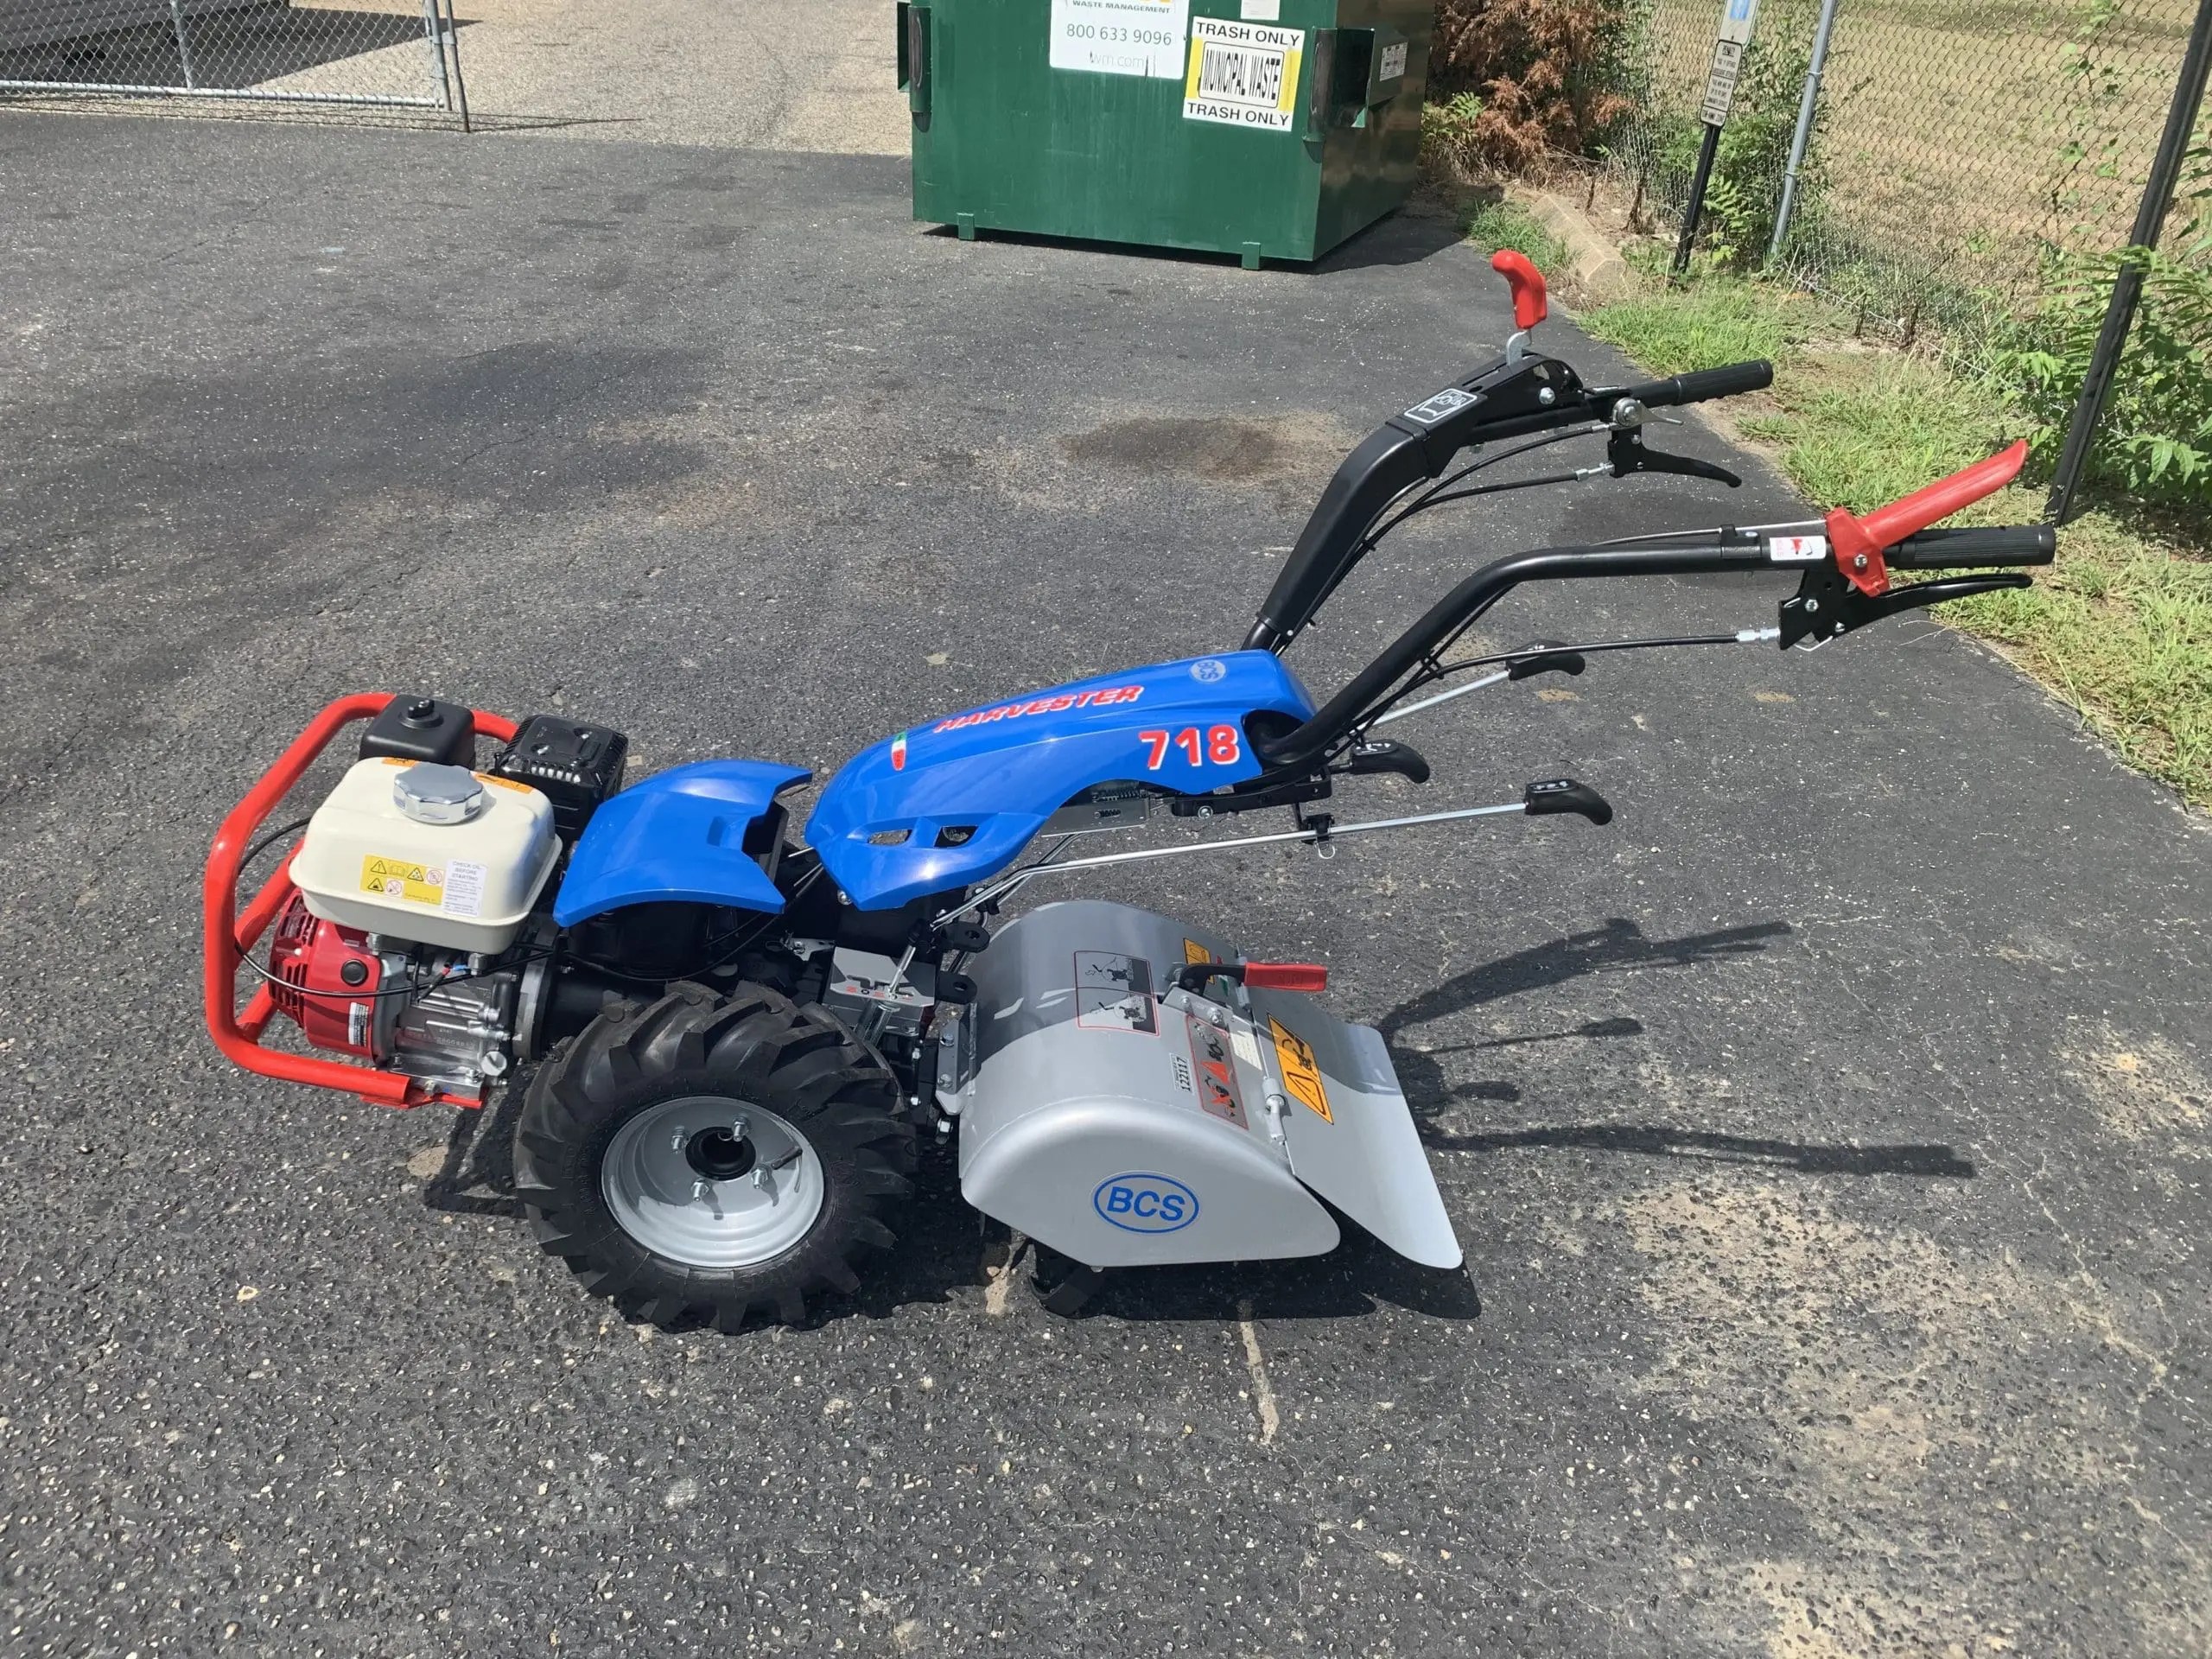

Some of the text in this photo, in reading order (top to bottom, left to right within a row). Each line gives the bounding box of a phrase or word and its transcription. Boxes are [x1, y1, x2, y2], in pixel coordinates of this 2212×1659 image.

[1072, 0, 1171, 14] WASTE MANAGEMENT
[1066, 23, 1173, 46] 800 633 9096
[1196, 22, 1300, 47] TRASH ONLY
[1202, 49, 1281, 100] MUNICIPAL WASTE
[1187, 102, 1289, 126] TRASH ONLY
[932, 685, 1145, 734] HARVESTER
[1138, 724, 1240, 771] 718
[1176, 1056, 1192, 1092] 122117
[1107, 1185, 1185, 1221] BCS
